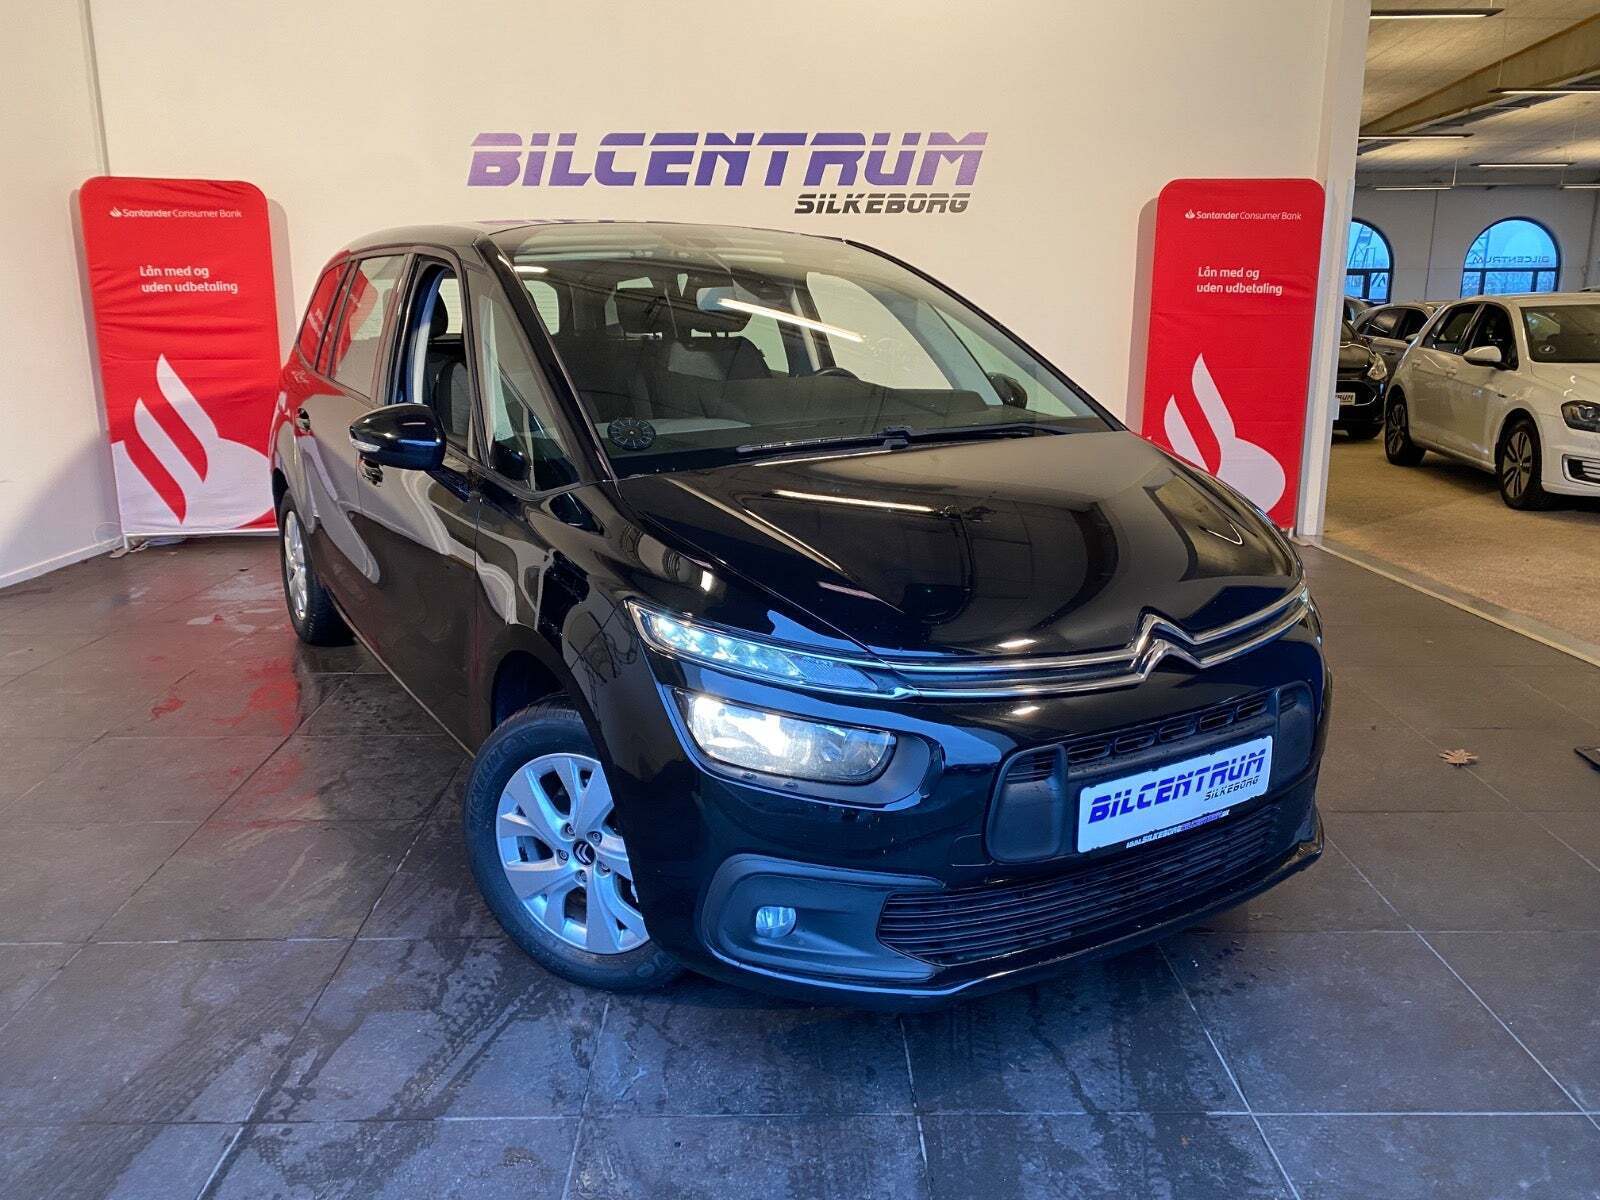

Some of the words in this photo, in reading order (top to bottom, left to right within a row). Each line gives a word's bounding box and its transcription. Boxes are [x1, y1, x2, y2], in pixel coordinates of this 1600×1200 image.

[466, 132, 988, 187] BILCENTRUM
[794, 192, 971, 214] SILKEBORG
[122, 208, 171, 218] Santander
[172, 209, 217, 218] Consumer
[219, 209, 242, 218] Bank
[1196, 210, 1239, 220] Santander
[1240, 211, 1280, 220] Consumer
[1281, 212, 1302, 221] Bank
[139, 265, 161, 277] Lån
[164, 266, 191, 277] med
[194, 268, 209, 279] og
[1197, 266, 1217, 279] Lån
[1219, 267, 1243, 279] med
[1245, 270, 1260, 282] og
[141, 280, 172, 293] uden
[175, 281, 238, 295] udbetaling
[1196, 283, 1223, 294] uden
[1225, 283, 1283, 297] udbetaling
[1088, 749, 1267, 825] BILCENTRUM
[1203, 775, 1260, 802] SILKEBORG
